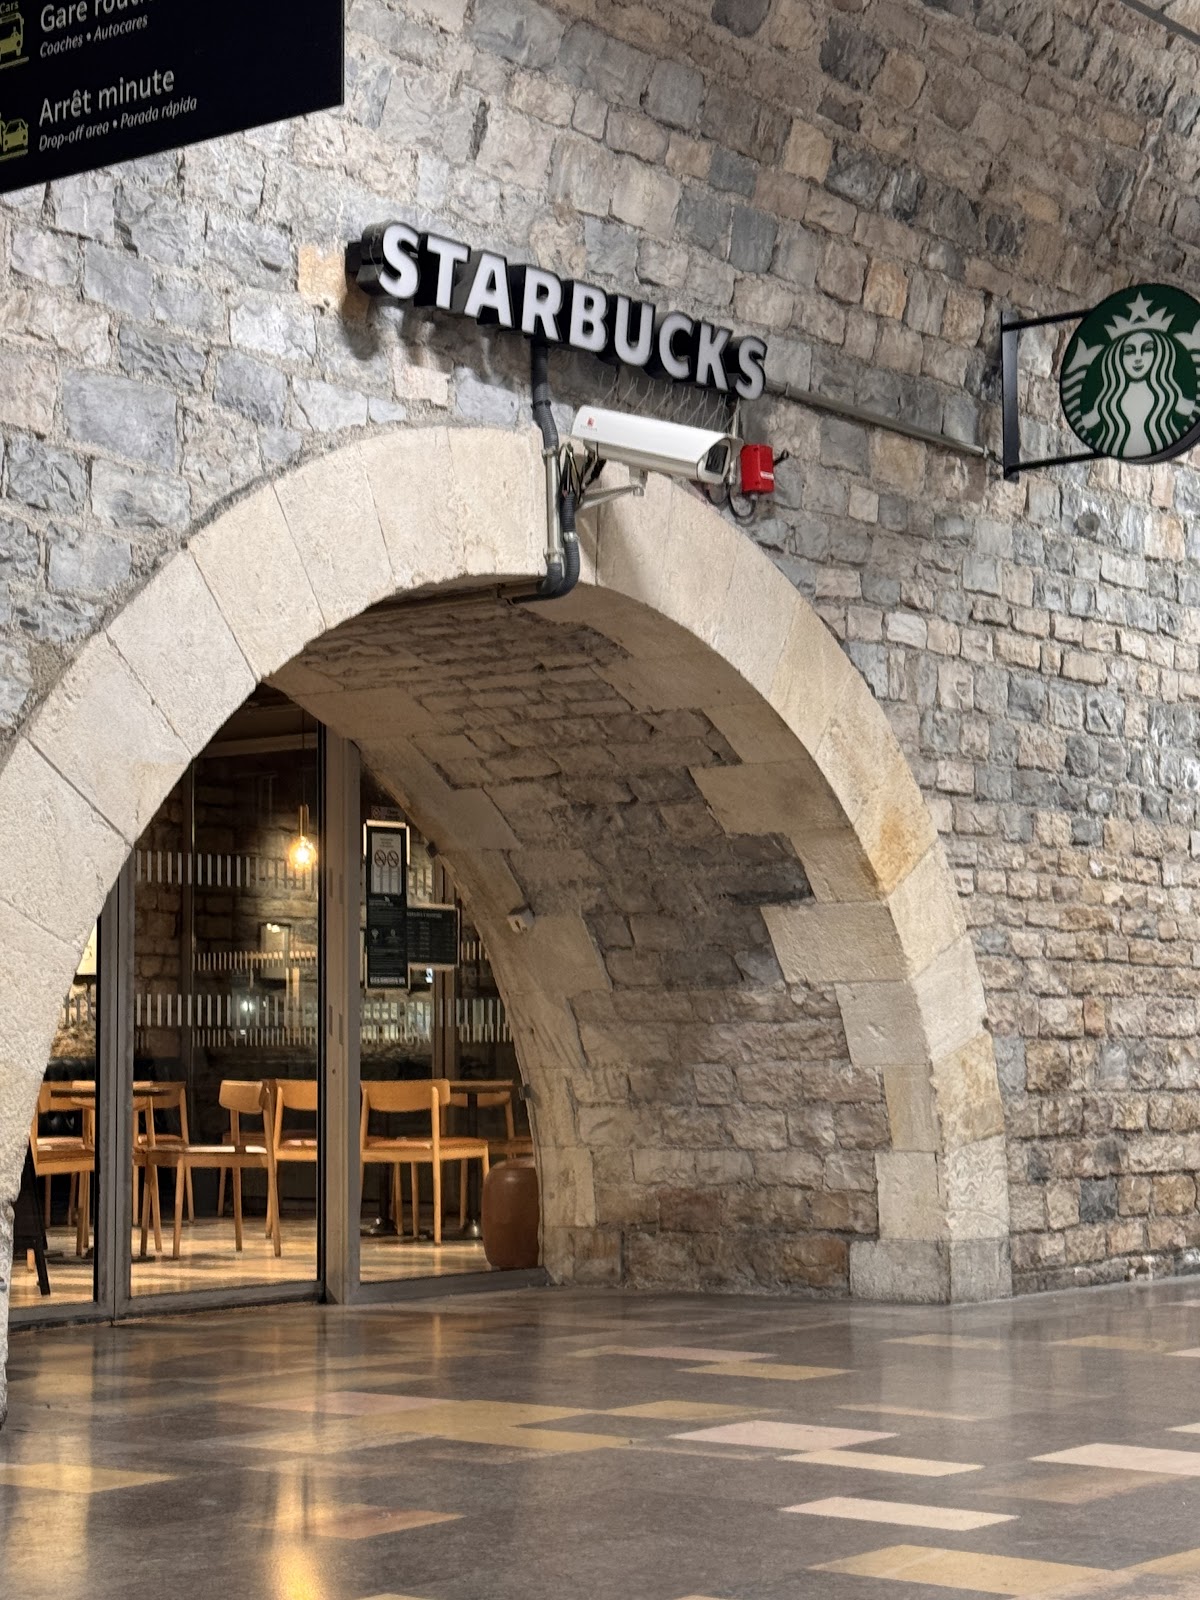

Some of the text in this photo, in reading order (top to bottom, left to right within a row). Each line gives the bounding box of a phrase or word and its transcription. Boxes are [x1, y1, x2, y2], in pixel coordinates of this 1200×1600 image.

[0, 1, 19, 14] Cars
[40, 0, 88, 32] Gare
[40, 14, 149, 58] Coaches Autocares
[38, 69, 175, 127] Arrêt minute
[38, 96, 198, 151] Drop-off area Parada rápida
[378, 220, 768, 400] STARBUCKS
